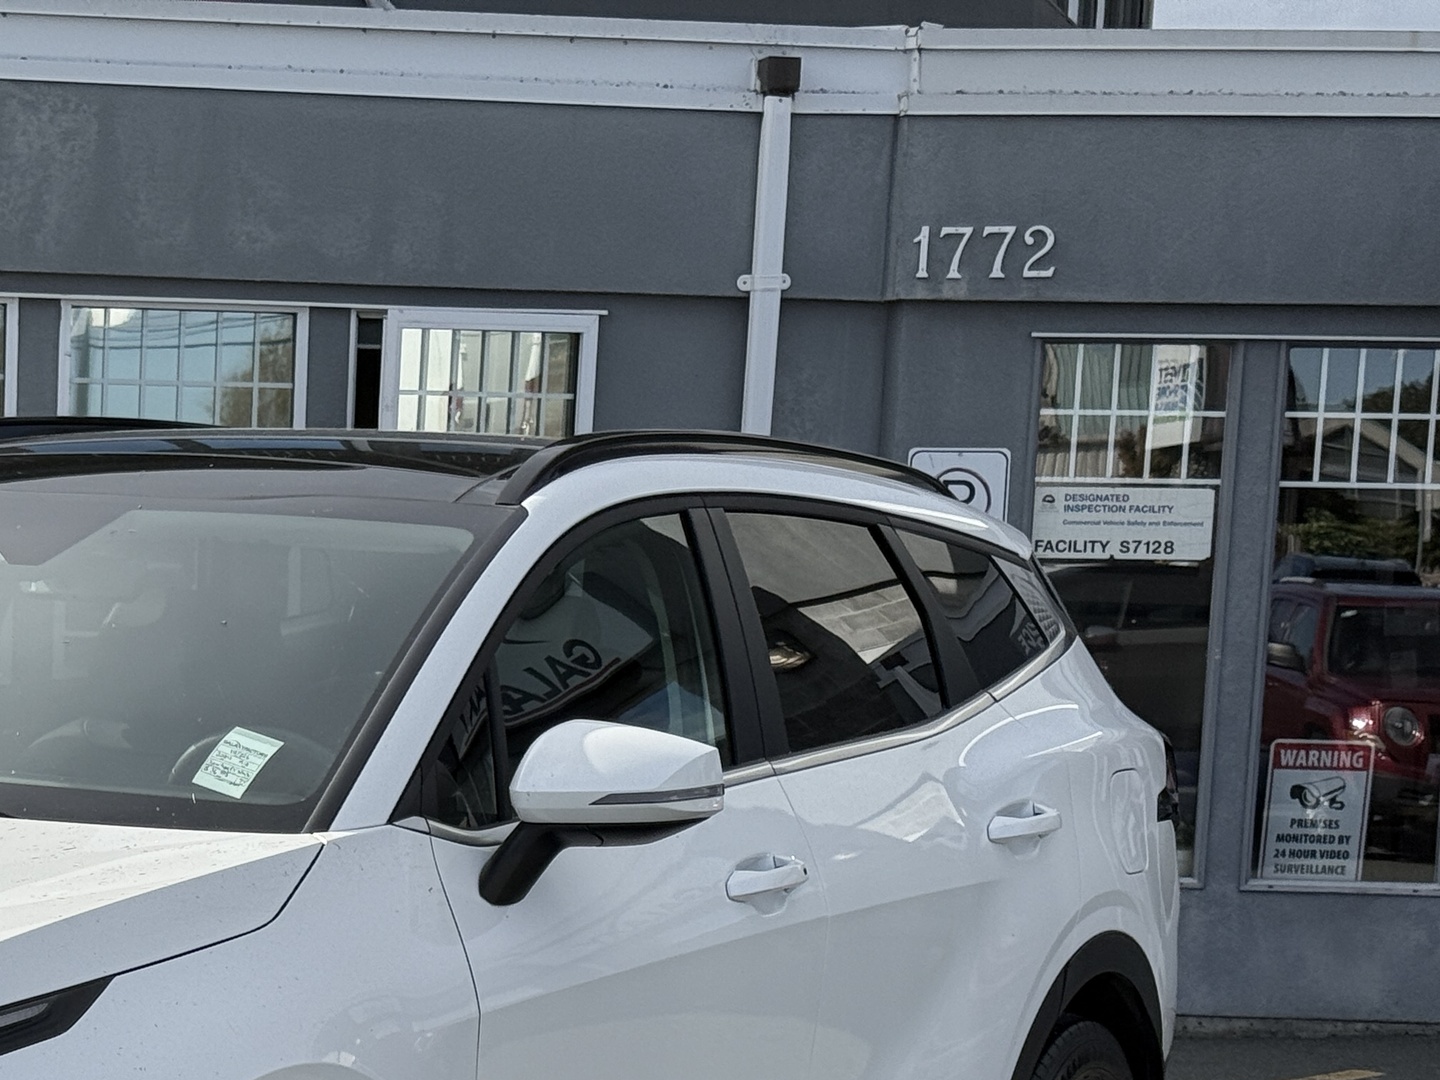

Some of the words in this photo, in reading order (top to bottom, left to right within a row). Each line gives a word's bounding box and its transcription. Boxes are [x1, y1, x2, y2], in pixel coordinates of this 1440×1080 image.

[913, 225, 1056, 279] 1772
[1064, 493, 1130, 503] DESIGNATED
[1063, 504, 1127, 514] INSPECTION
[1128, 504, 1175, 514] FACILITY
[1126, 519, 1147, 527] Safety
[1034, 539, 1111, 553] FACILITY
[1118, 540, 1175, 555] S7128
[1280, 749, 1364, 768] WARNING
[1275, 834, 1335, 845] MONITORED
[1337, 835, 1351, 845] BY
[1273, 848, 1287, 858] 24
[1288, 849, 1317, 860] HOUR
[1319, 850, 1350, 860] VIDEO
[1273, 863, 1347, 876] SURVEILLANCE
